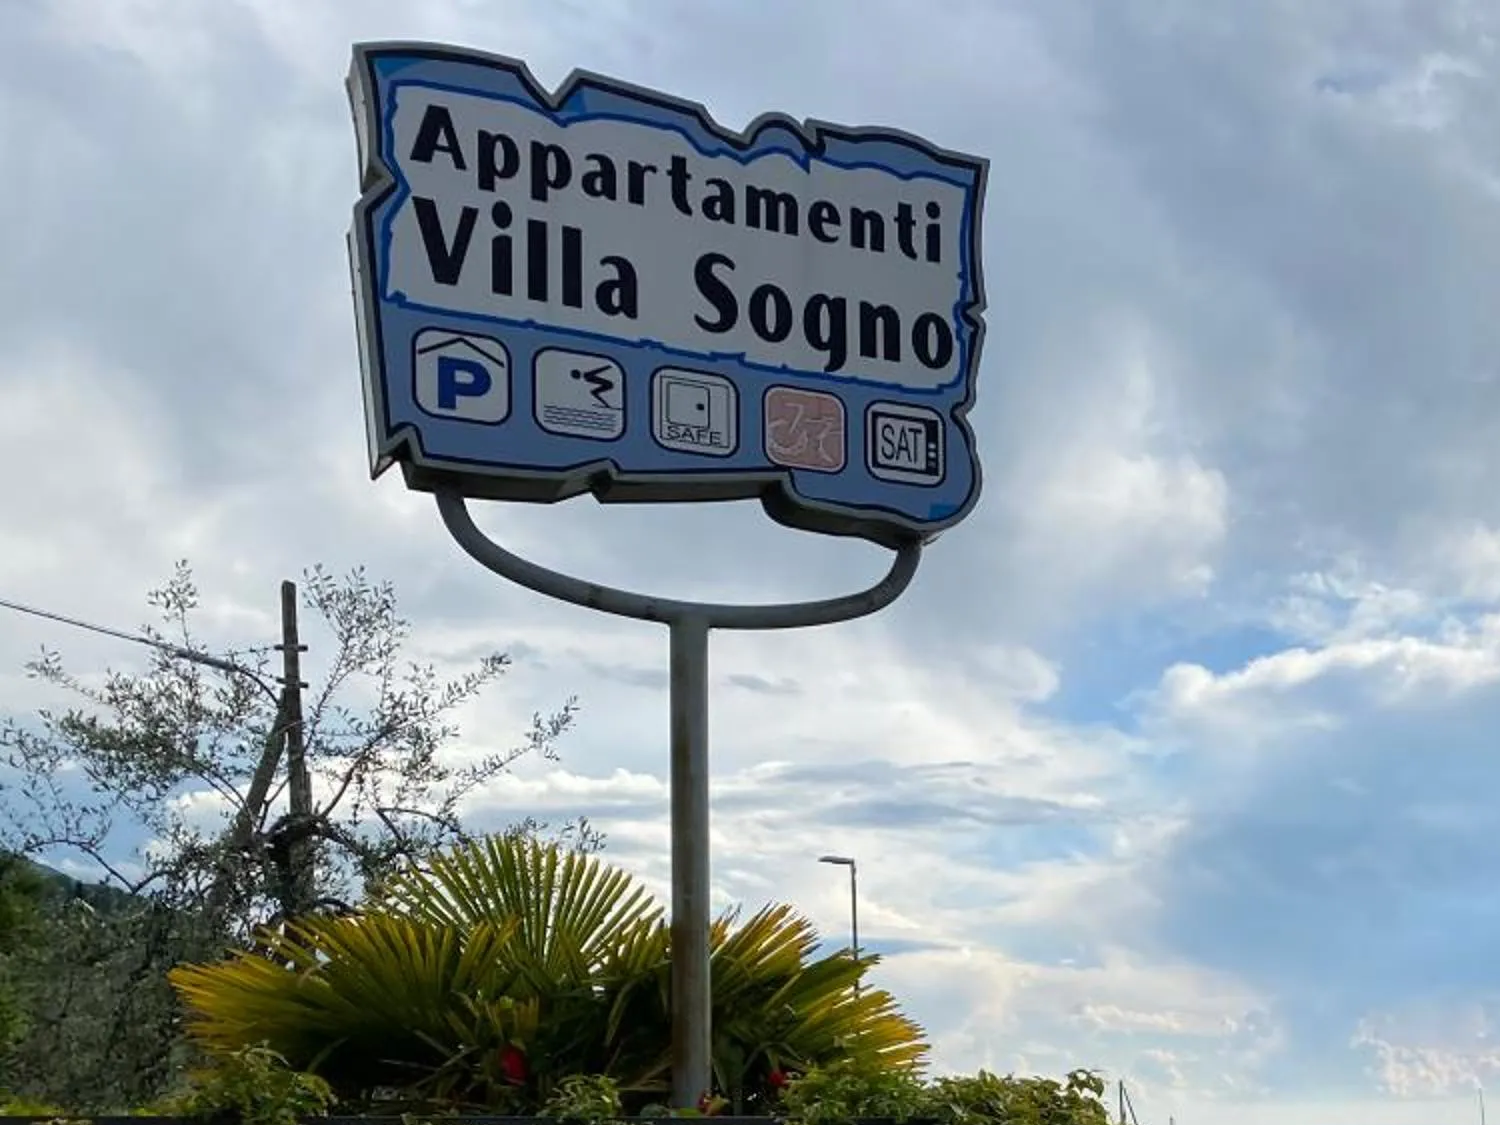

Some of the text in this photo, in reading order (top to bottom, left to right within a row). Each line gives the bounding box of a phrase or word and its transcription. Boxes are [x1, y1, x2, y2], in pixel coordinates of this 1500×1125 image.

[409, 103, 942, 264] Appartamenti
[411, 195, 954, 373] Villa Sogno
[437, 355, 492, 411] P
[665, 425, 721, 446] SAFE
[880, 422, 924, 465] SAT
